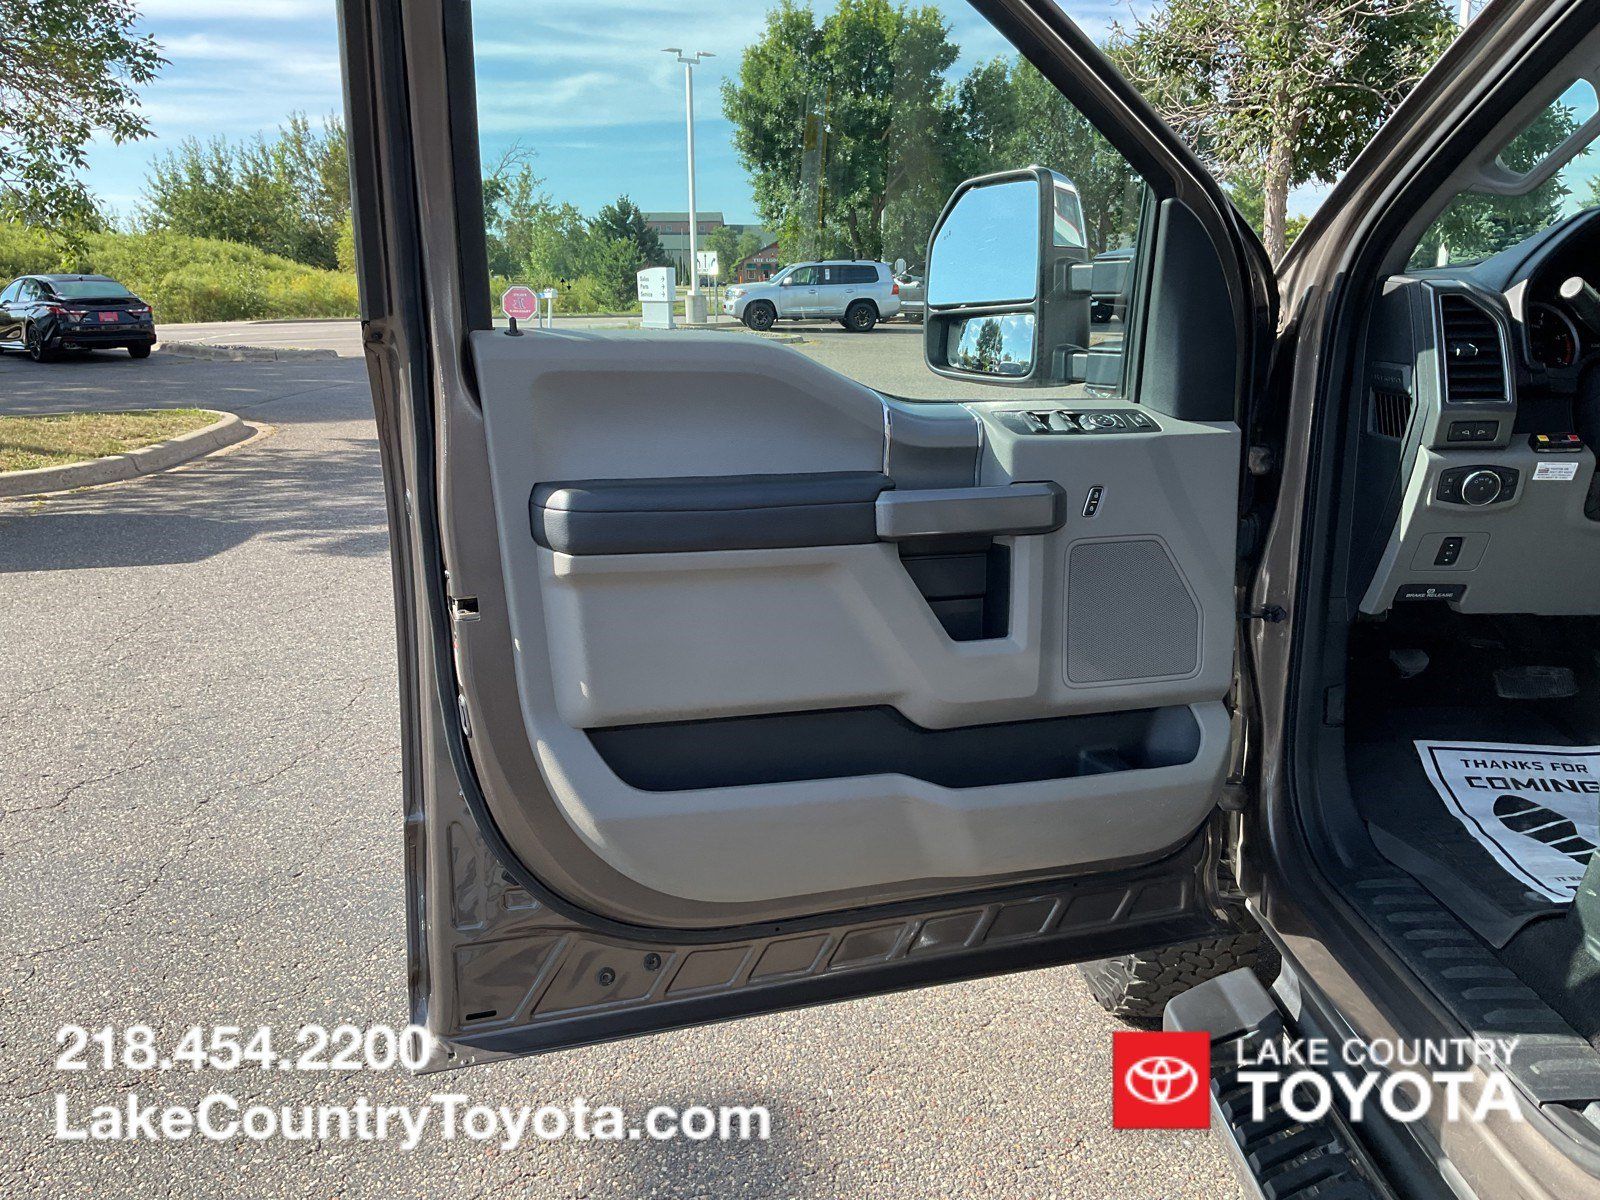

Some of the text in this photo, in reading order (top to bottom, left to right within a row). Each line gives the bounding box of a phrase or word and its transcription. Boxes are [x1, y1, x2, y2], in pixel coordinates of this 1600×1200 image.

[1460, 758, 1589, 773] THANKS FOR
[1464, 775, 1600, 794] COMING
